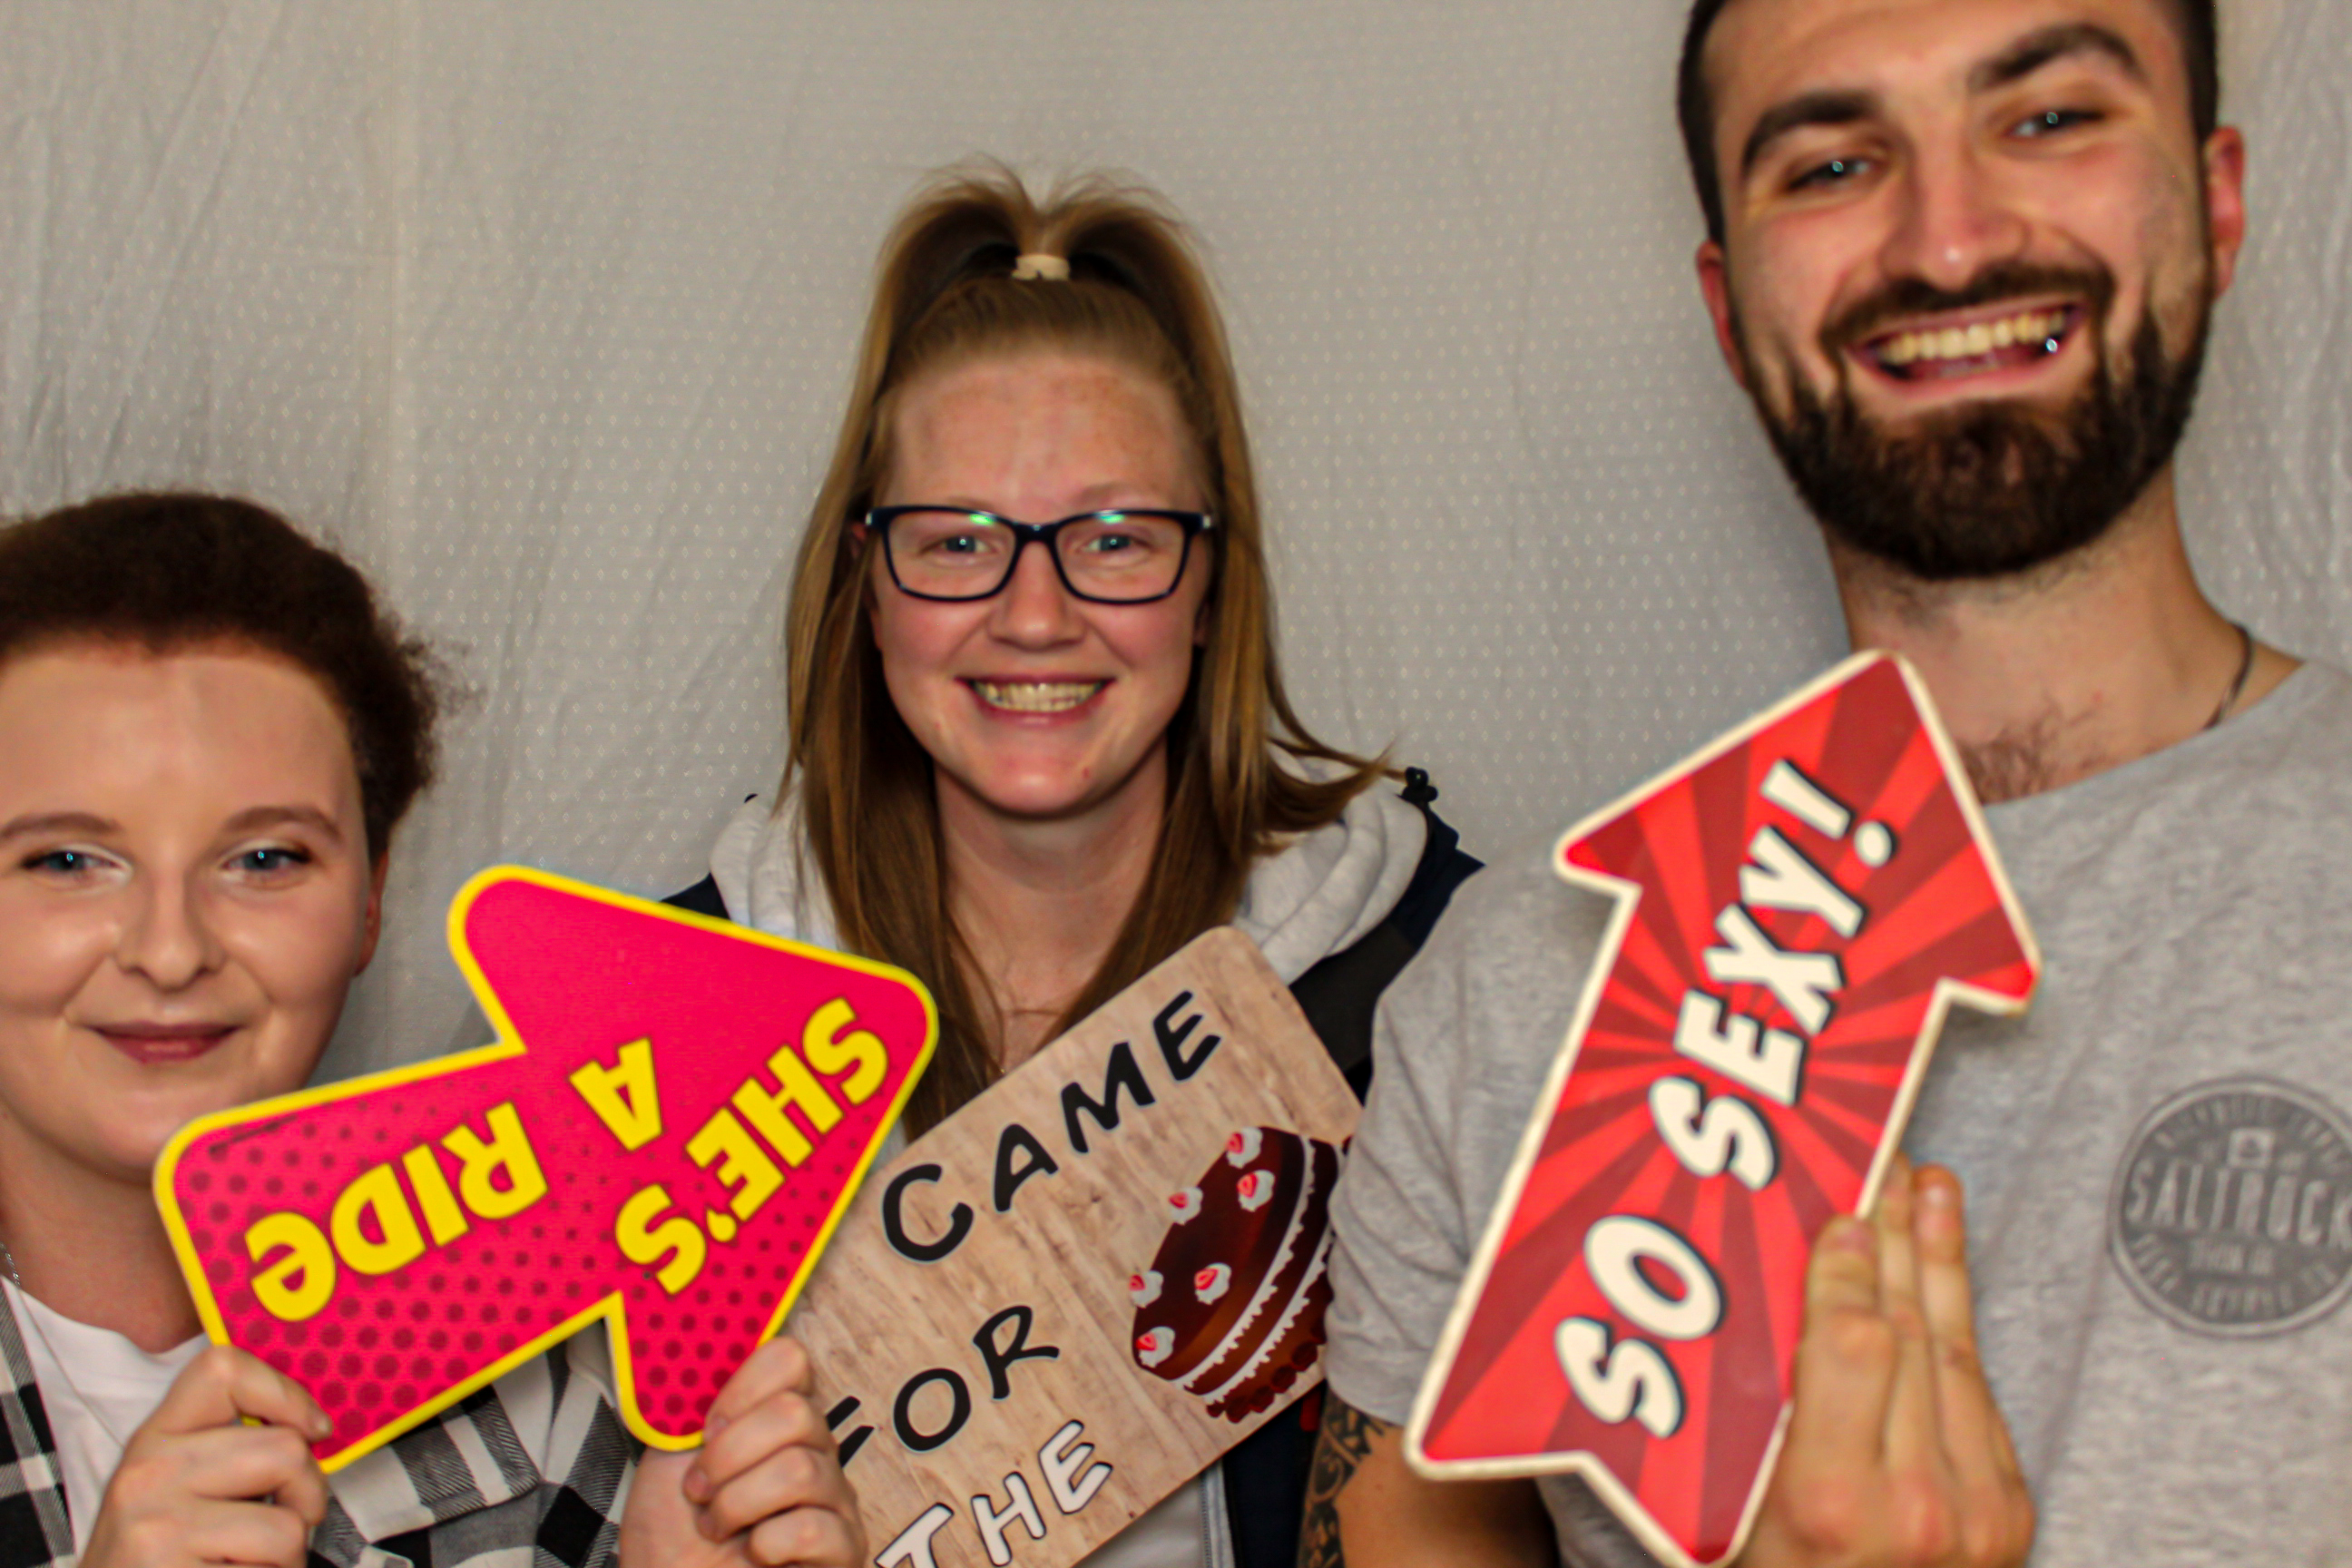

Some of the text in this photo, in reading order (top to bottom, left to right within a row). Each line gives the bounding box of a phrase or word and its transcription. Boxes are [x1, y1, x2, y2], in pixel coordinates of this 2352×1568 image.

[568, 1035, 663, 1152] A
[614, 997, 889, 1296] SHE'S
[881, 990, 1221, 1262] CAME
[1554, 758, 1896, 1439] SO SEXY!
[874, 1419, 1113, 1568] THE
